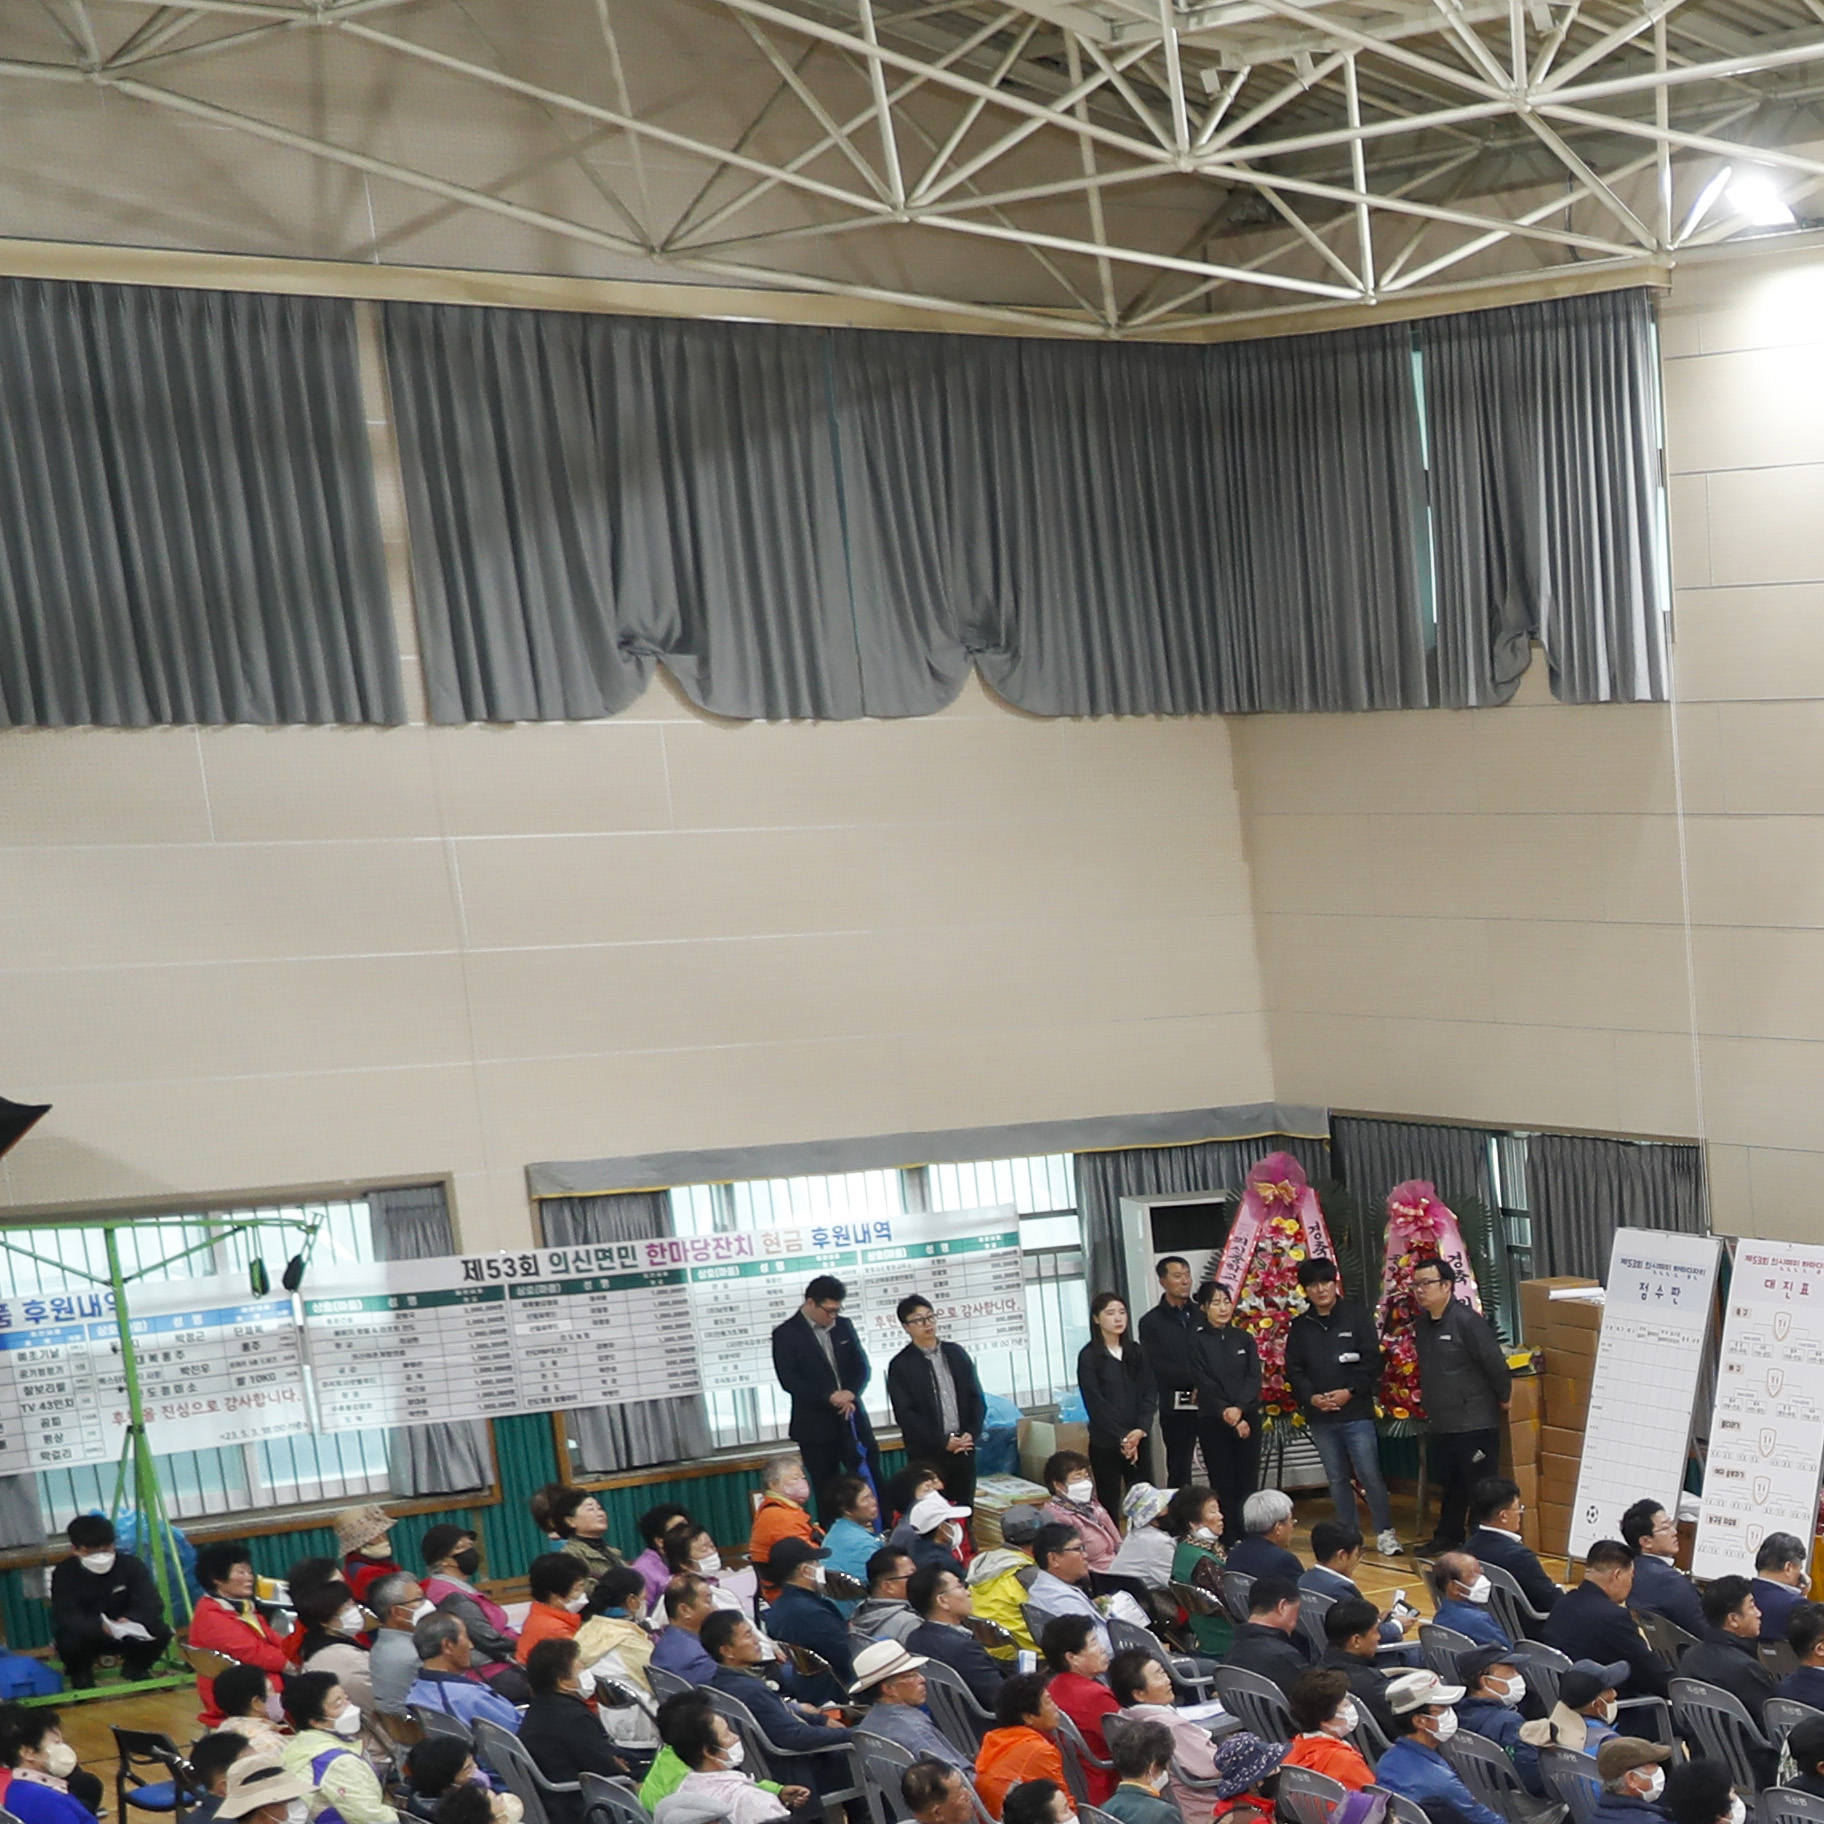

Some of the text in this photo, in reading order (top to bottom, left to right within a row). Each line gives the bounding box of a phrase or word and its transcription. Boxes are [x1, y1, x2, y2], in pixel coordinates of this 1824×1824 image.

[461, 1220, 893, 1282] 제53회 의신면민 한마당잔치 현금 후원내역
[1449, 1252, 1470, 1286] 경축
[875, 1298, 1020, 1328] 후원 감사합니다.
[20, 1401, 37, 1413] TV
[112, 1407, 156, 1426] 후을
[224, 1388, 302, 1413] 감사합니다.
